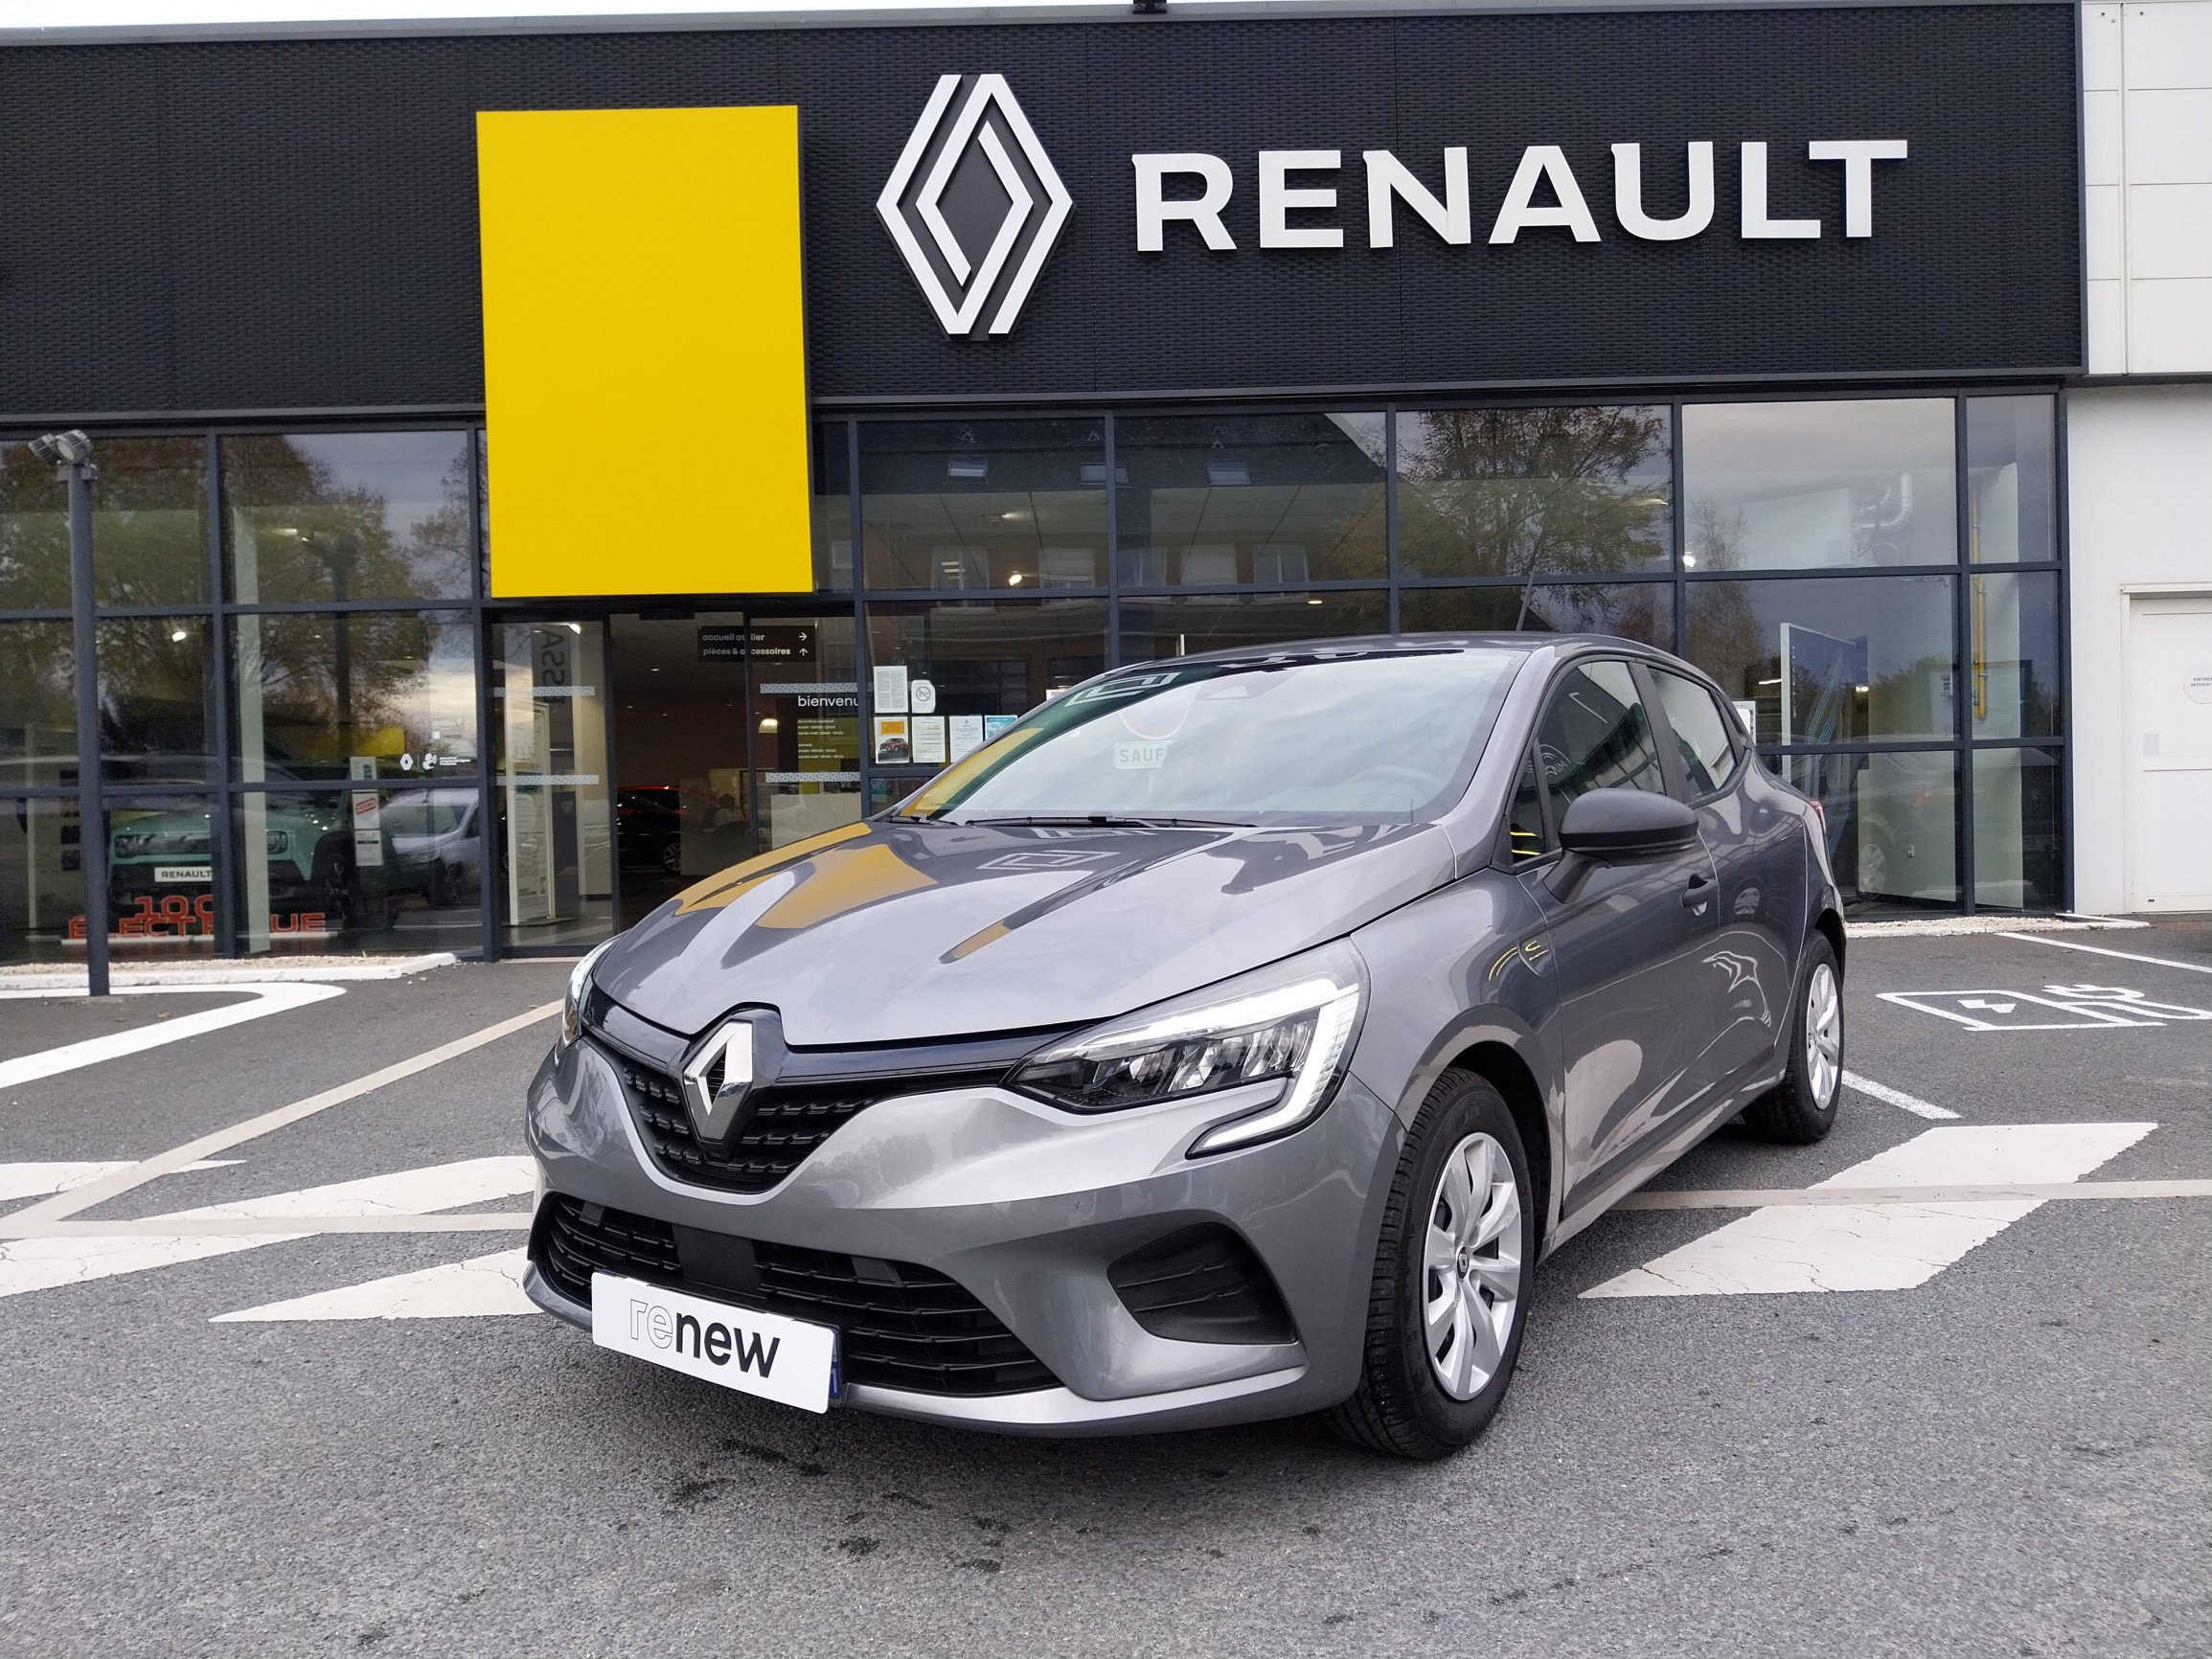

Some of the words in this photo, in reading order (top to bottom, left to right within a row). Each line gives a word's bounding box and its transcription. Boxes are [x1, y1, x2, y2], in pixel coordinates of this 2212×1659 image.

[1131, 140, 1907, 251] RENAULT
[703, 648, 731, 656] pièces
[1119, 748, 1164, 763] SAUF
[161, 870, 212, 878] RENAULT
[629, 1298, 781, 1379] renew
